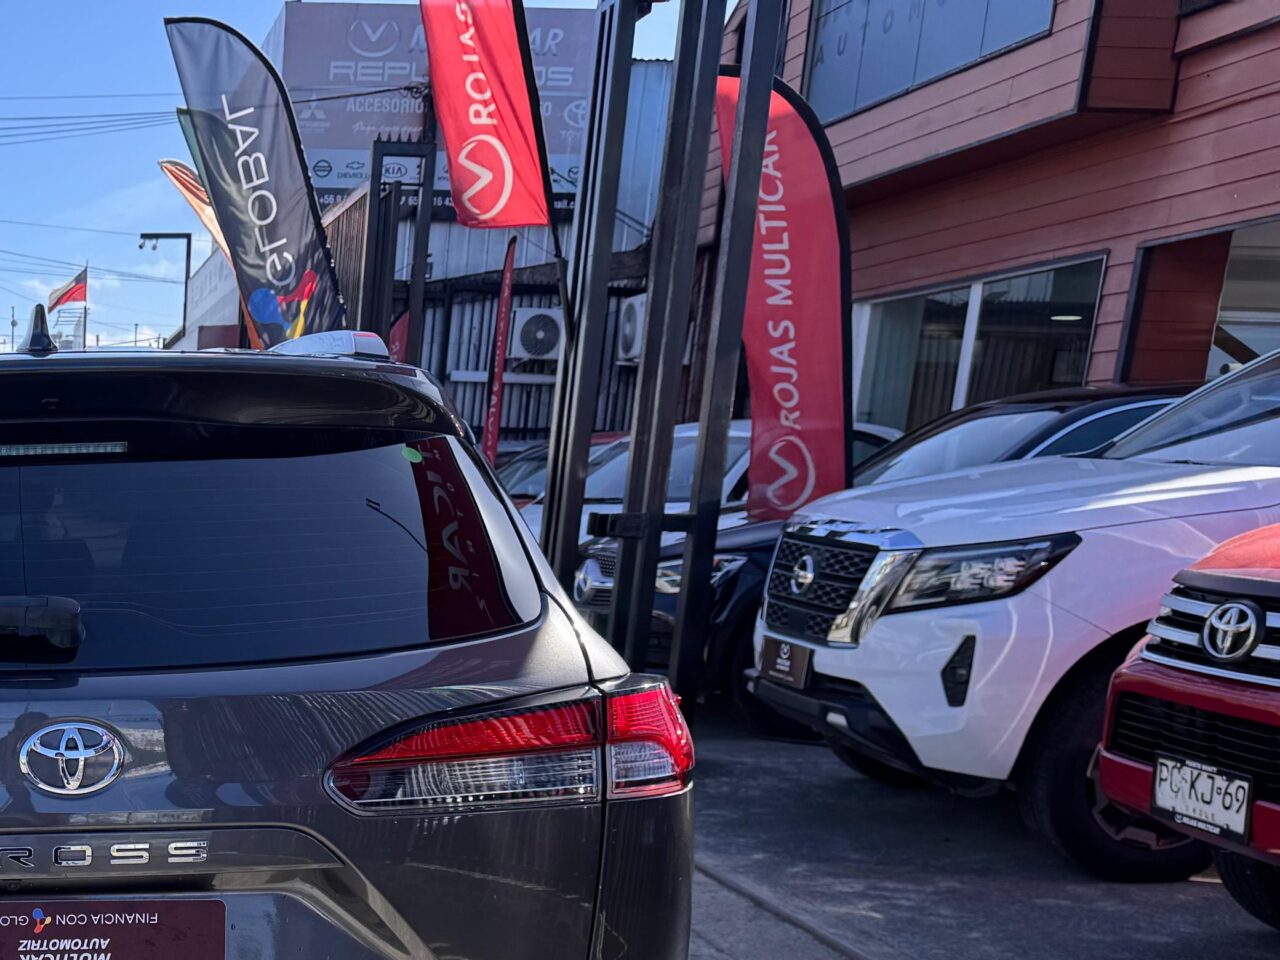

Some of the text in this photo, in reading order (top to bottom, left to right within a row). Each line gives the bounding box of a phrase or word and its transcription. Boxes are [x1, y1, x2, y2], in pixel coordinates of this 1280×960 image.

[346, 97, 425, 113] ACCESORIO
[384, 167, 403, 175] KIA
[221, 94, 295, 286] GLOBAL
[768, 319, 801, 431] ROJAS
[56, 914, 88, 925] CON
[91, 913, 159, 925] FINANCIA
[17, 938, 111, 951] AUTOMOTRIZ
